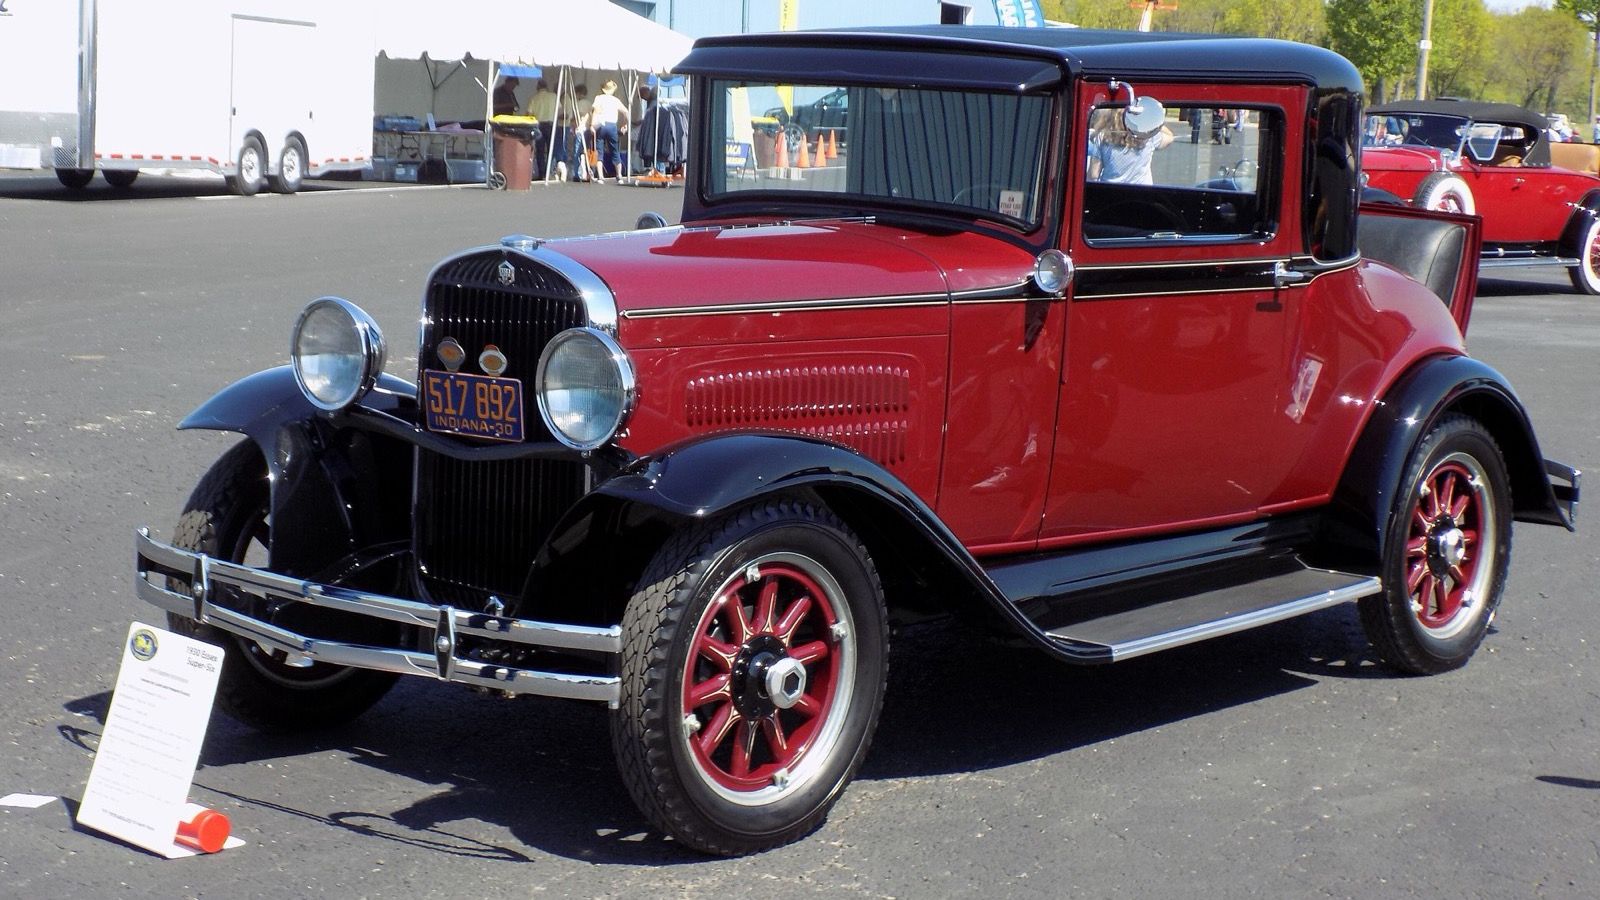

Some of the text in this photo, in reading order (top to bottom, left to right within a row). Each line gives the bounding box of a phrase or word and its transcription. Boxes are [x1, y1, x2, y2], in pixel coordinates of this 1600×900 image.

[429, 376, 517, 423] 517 892
[435, 415, 513, 436] INDIANA-30
